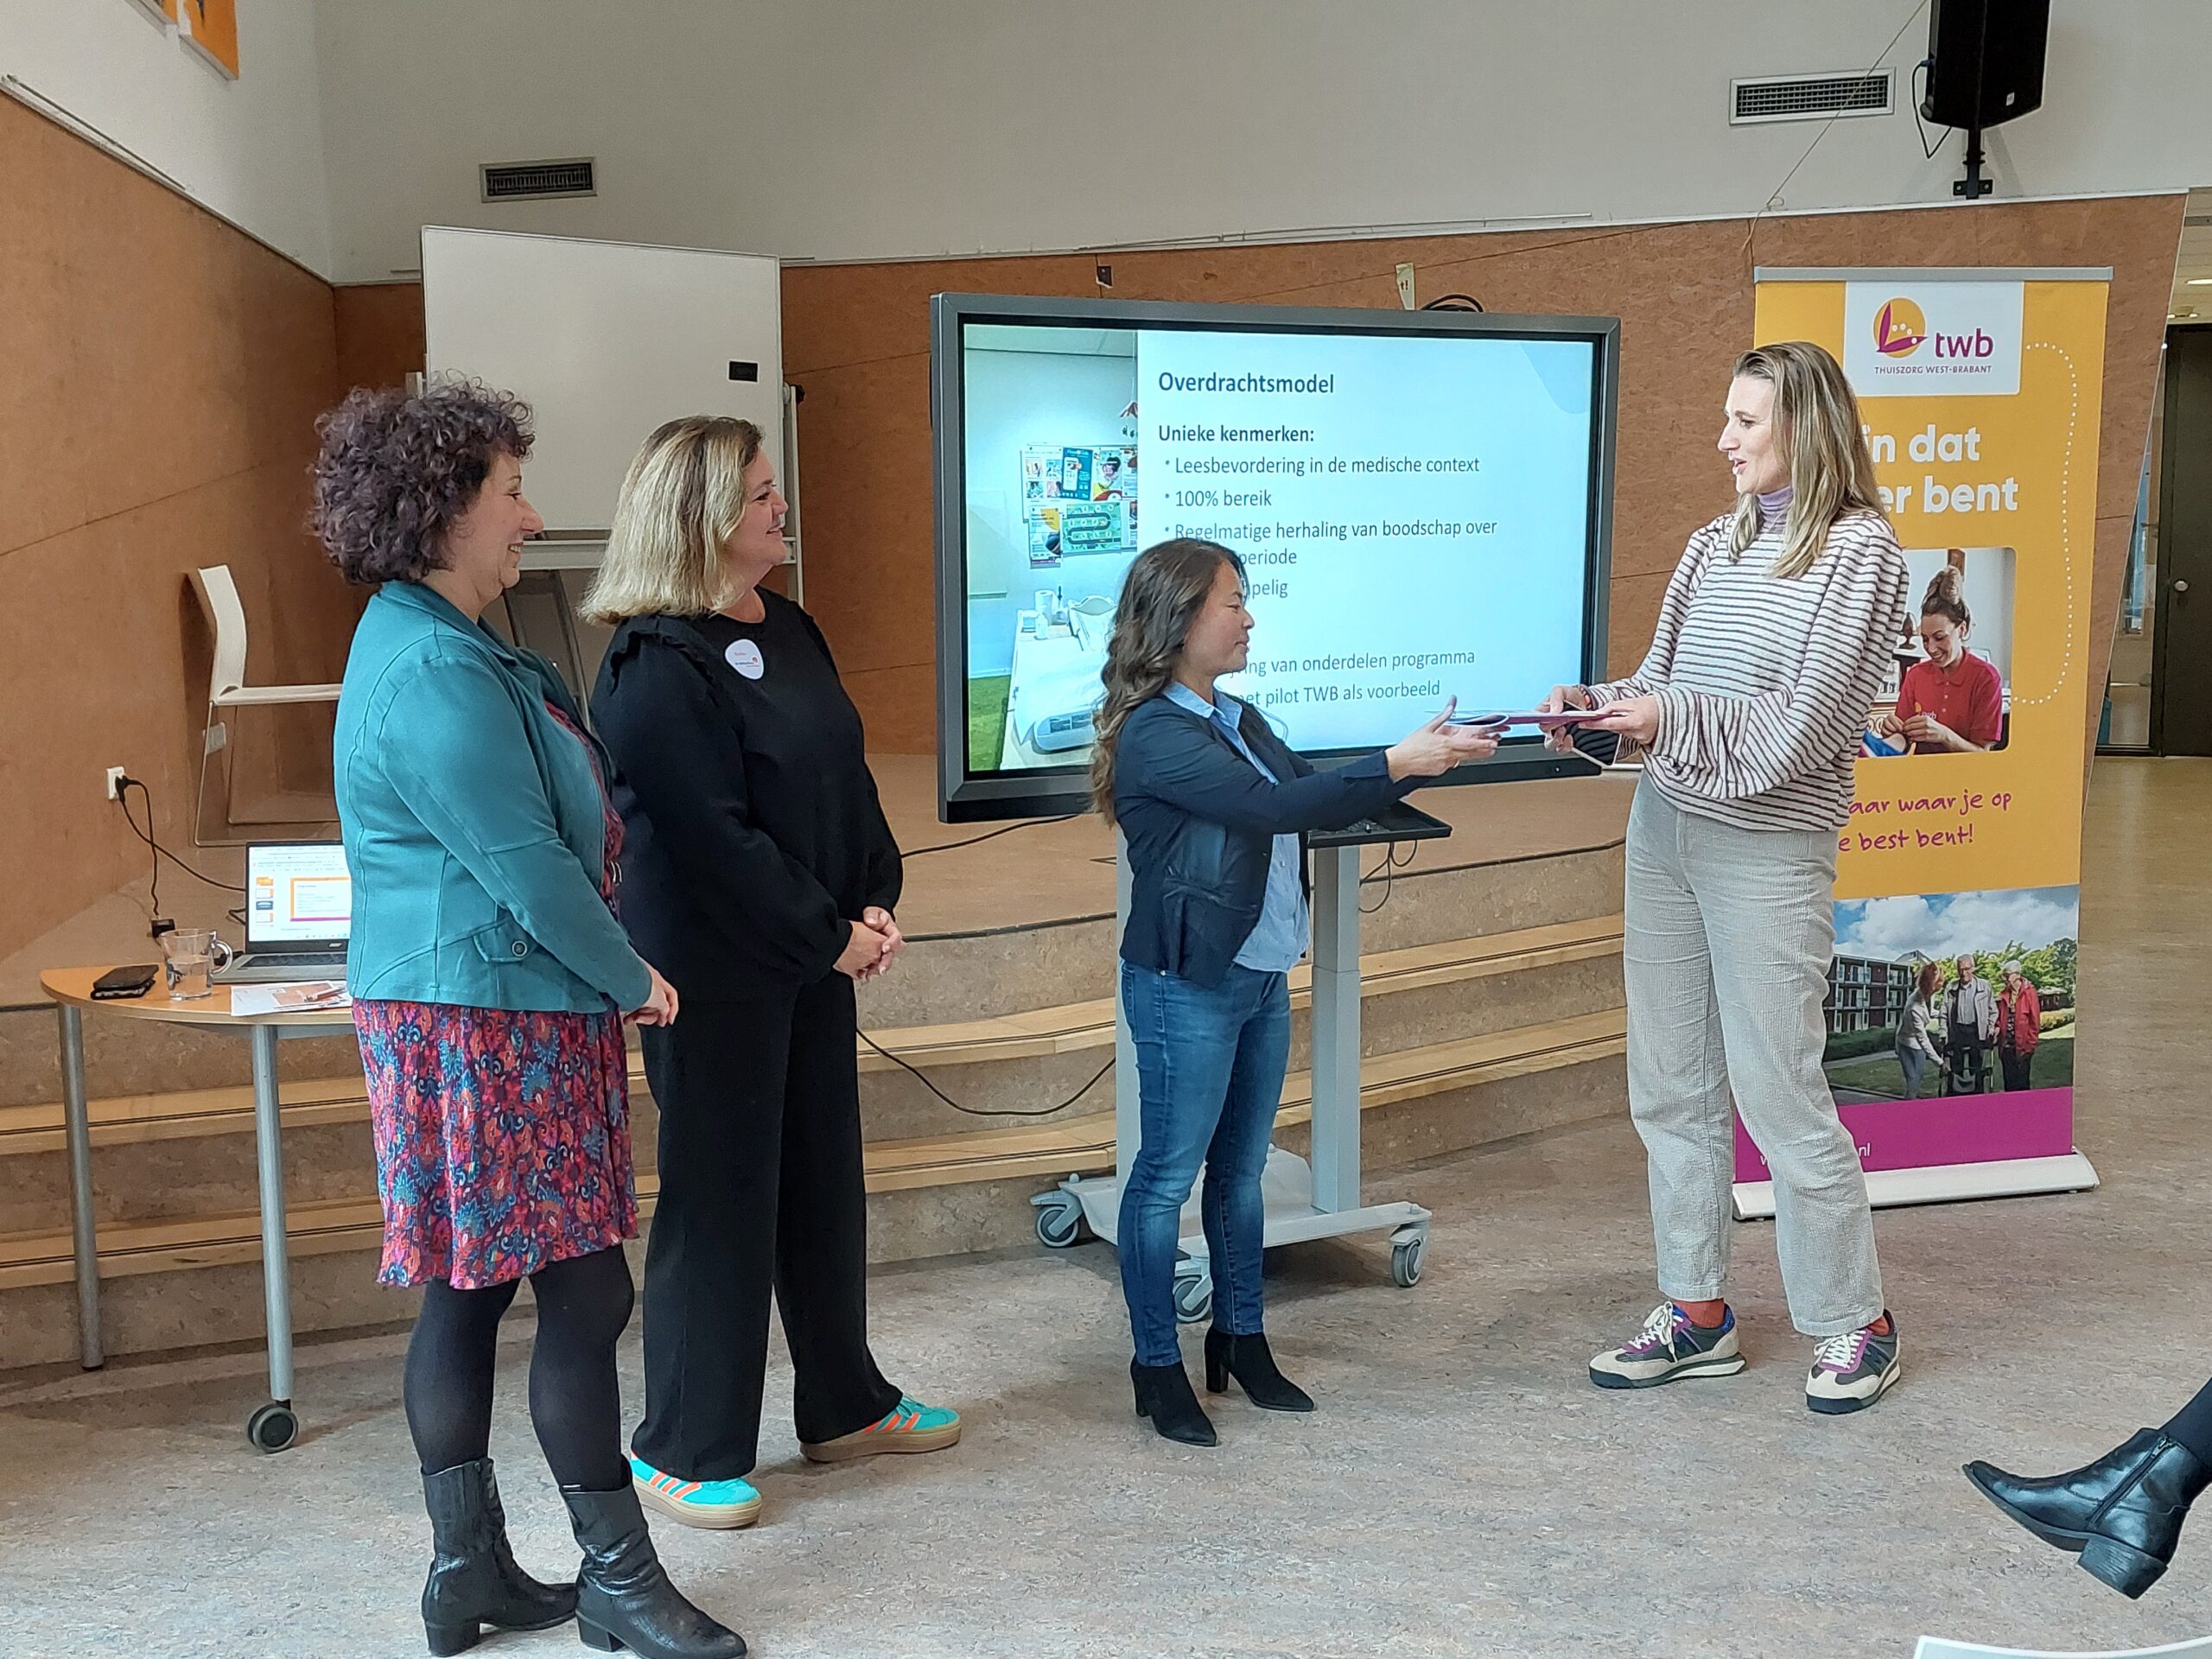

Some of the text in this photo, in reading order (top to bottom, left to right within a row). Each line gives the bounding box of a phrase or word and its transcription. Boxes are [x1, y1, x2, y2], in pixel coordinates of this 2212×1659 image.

[1936, 327, 1993, 358] twb
[1874, 365, 1992, 374] THUISZORG WEST-BRABANT
[1159, 372, 1334, 394] Overdrachtsmodel
[1159, 424, 1314, 442] Unieke kenmerken:
[1909, 423, 1981, 463] dat
[1176, 455, 1480, 477] Leesbevordering in de medische context
[1176, 489, 1272, 506] 100% bereik
[1923, 475, 2019, 513] bent
[1175, 519, 1497, 543] Regelmatige herhaling van boodschap over
[1271, 659, 1297, 672] van
[1302, 652, 1387, 671] onderdelen
[1392, 651, 1475, 671] programma
[1266, 688, 1299, 708] pilot
[1303, 686, 1338, 702] TWB
[1343, 683, 1363, 700] als
[1367, 679, 1440, 699] voorbeeld
[1848, 788, 2012, 816] aar waar je op
[1858, 829, 1910, 850] best
[1916, 823, 1974, 848] bent!
